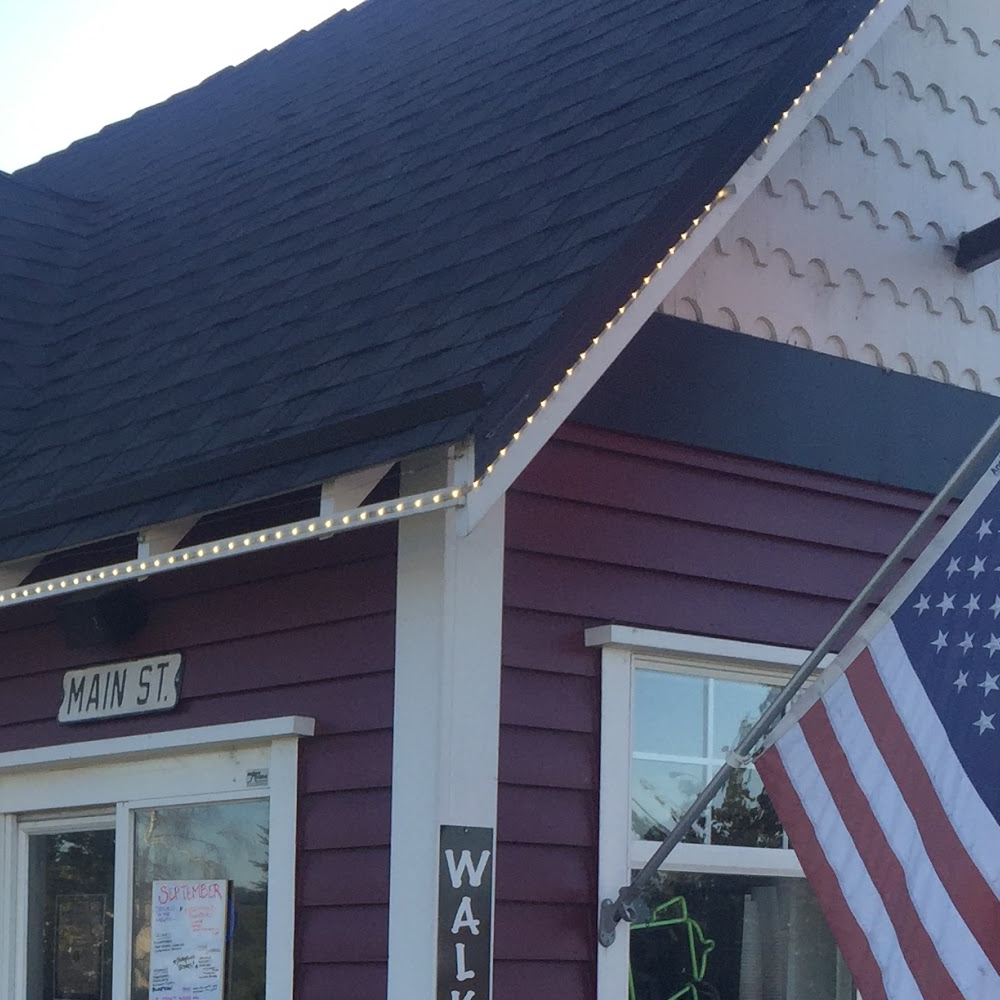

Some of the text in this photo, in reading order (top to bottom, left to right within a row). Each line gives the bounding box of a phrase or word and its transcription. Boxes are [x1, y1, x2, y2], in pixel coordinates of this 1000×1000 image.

[66, 662, 170, 715] MAIN ST.
[158, 883, 222, 905] SEPTEMBER
